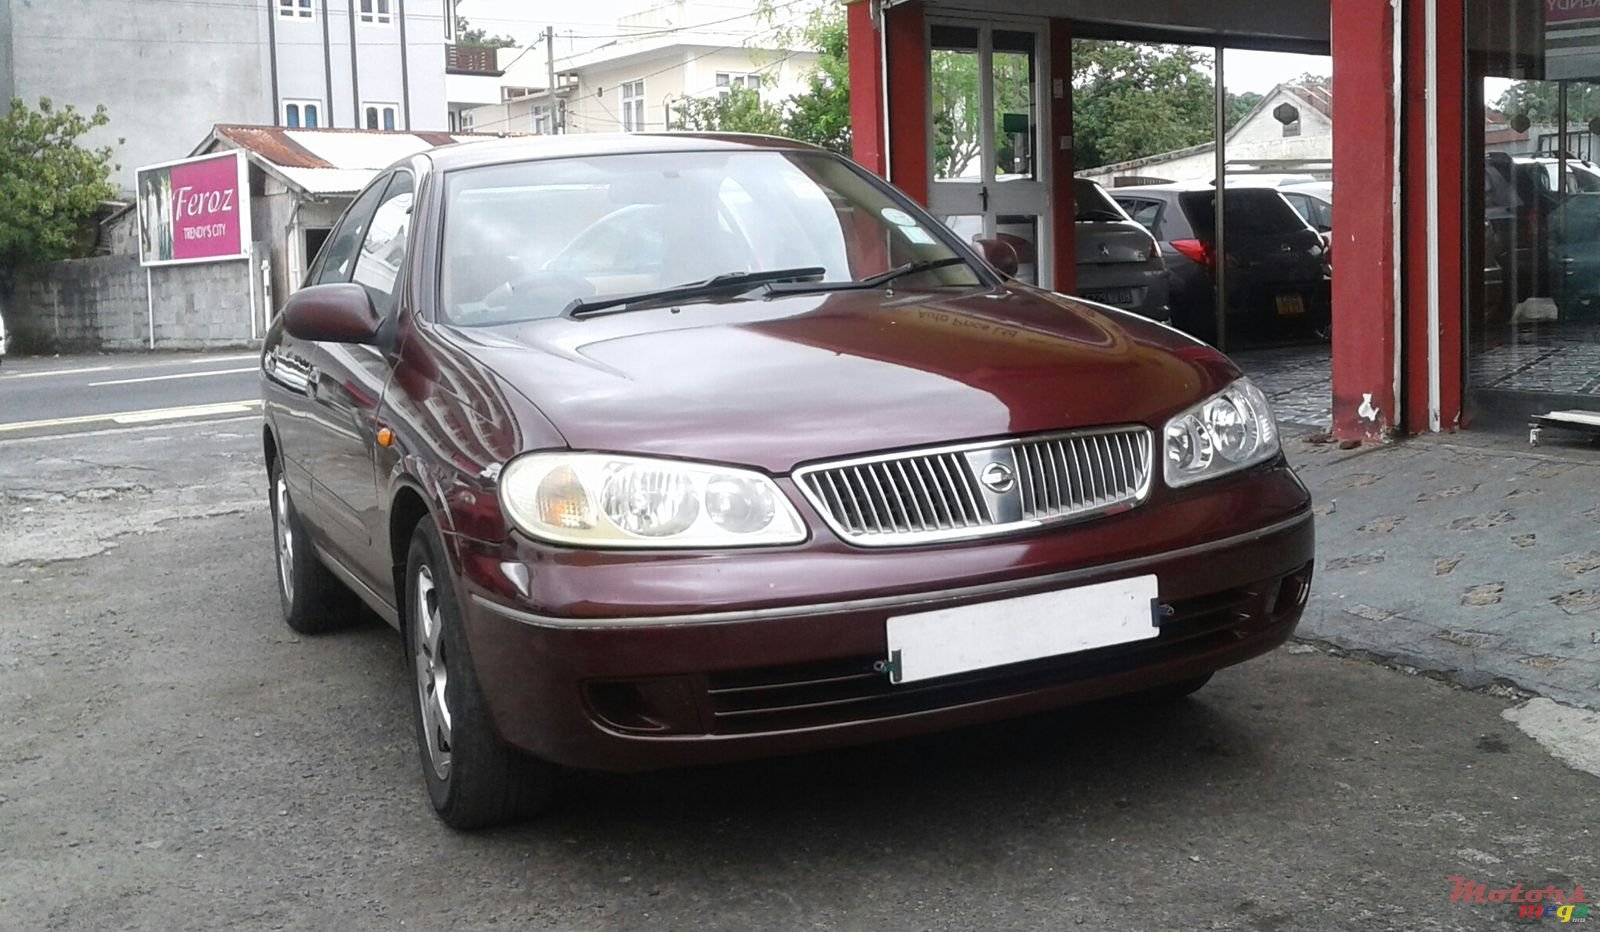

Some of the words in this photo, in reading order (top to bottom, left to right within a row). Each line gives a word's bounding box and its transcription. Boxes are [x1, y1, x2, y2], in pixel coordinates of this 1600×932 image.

[172, 186, 233, 221] Feroz
[183, 224, 211, 240] TRENDY'S
[212, 223, 226, 237] CITY
